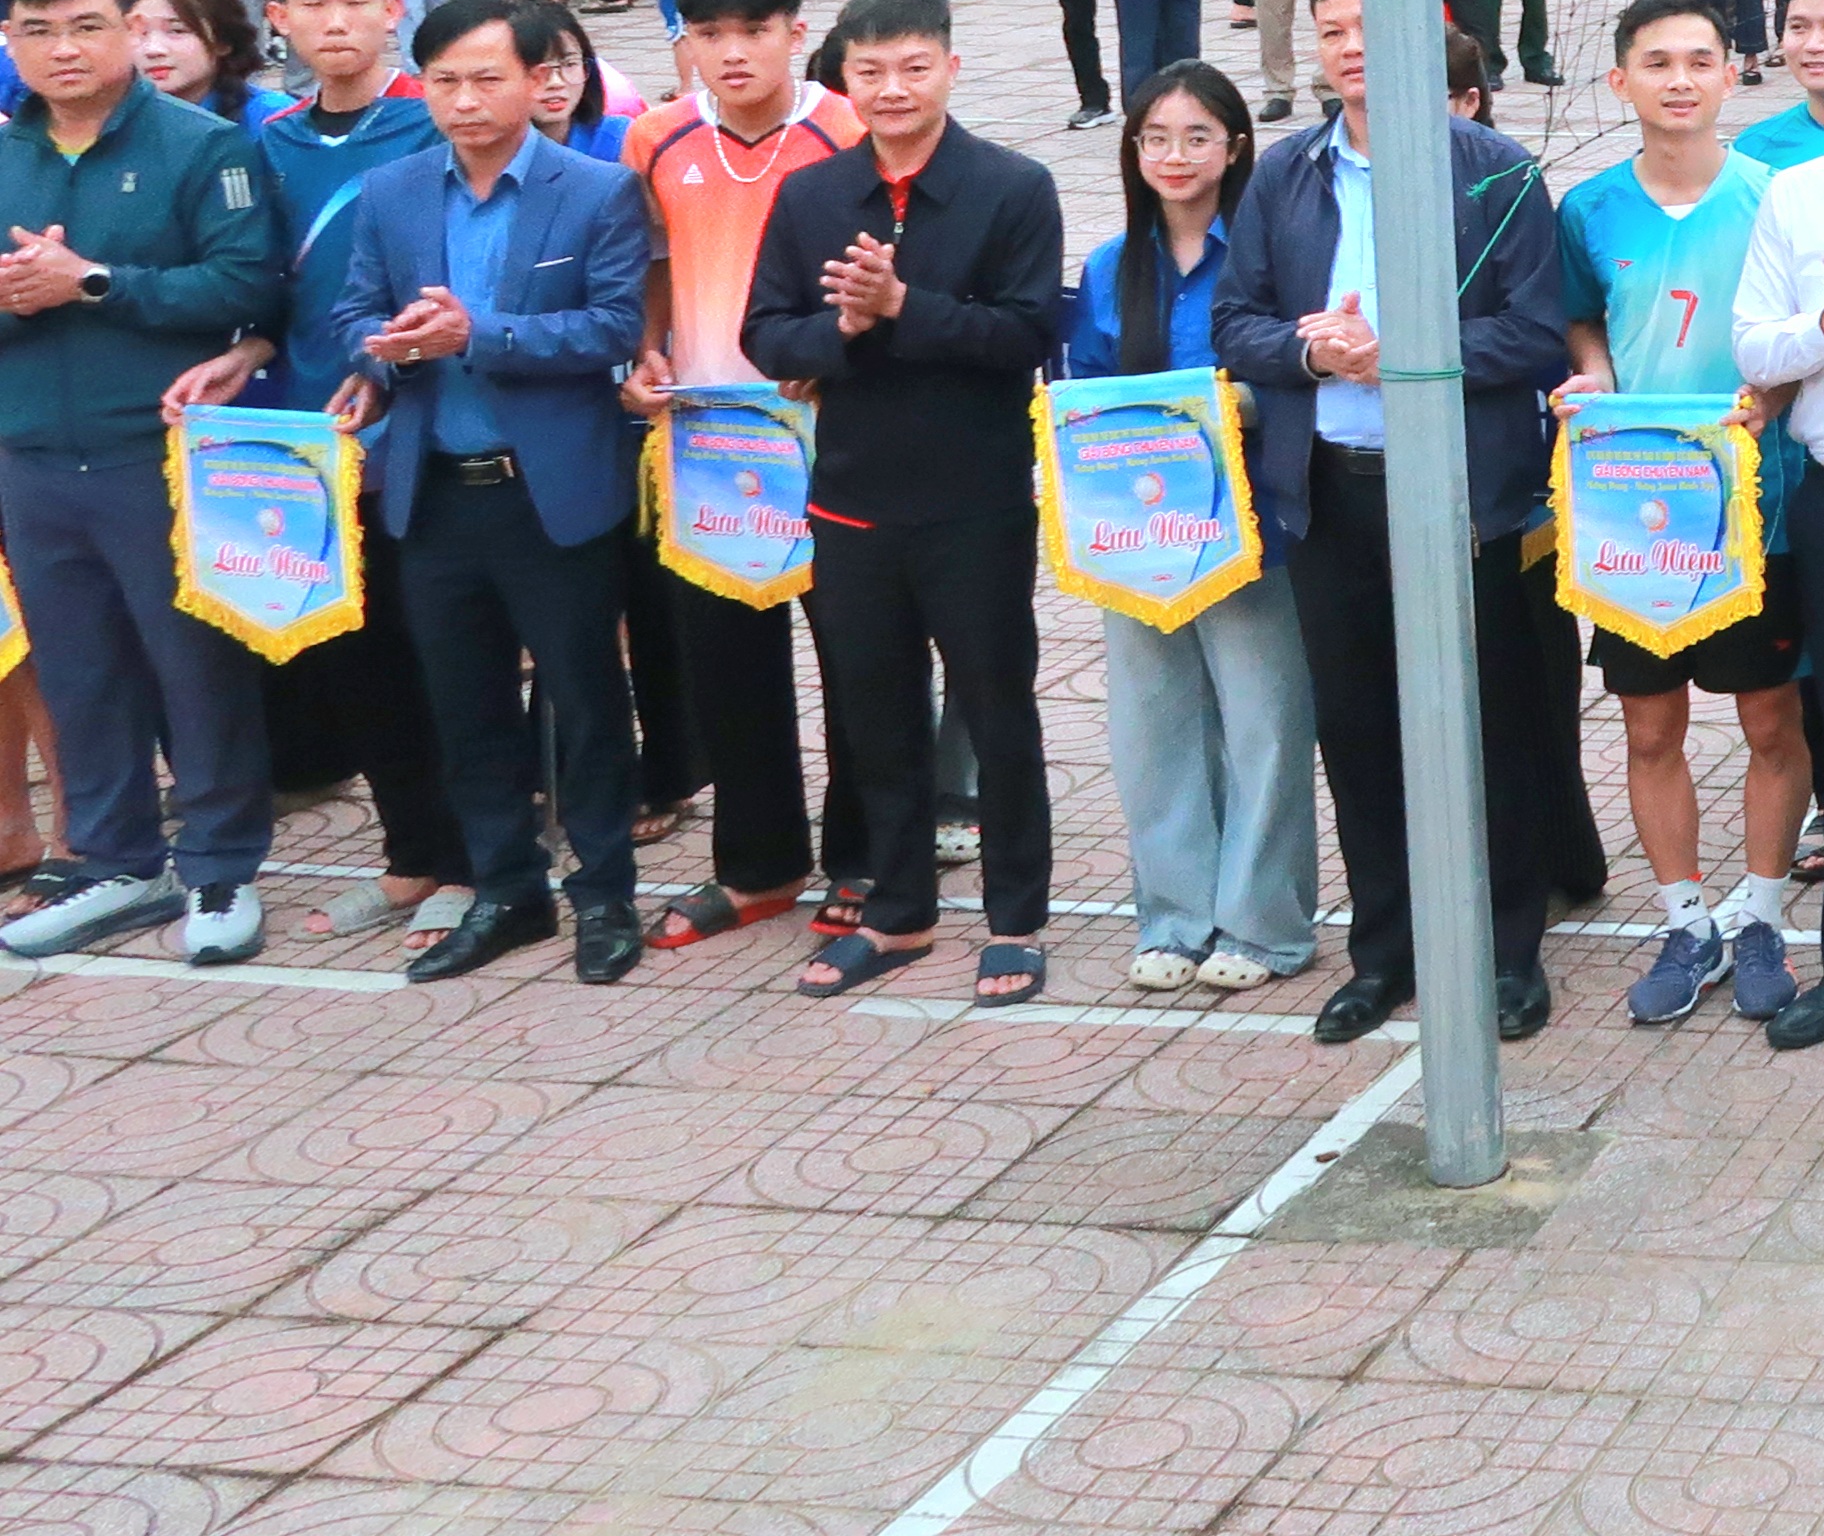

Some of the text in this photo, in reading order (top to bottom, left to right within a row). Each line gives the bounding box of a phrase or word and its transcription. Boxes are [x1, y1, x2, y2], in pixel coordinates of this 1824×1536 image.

[1669, 289, 1698, 347] 7
[1089, 510, 1224, 556] Lưu Niệm
[1594, 539, 1724, 581] Lưu Niệm
